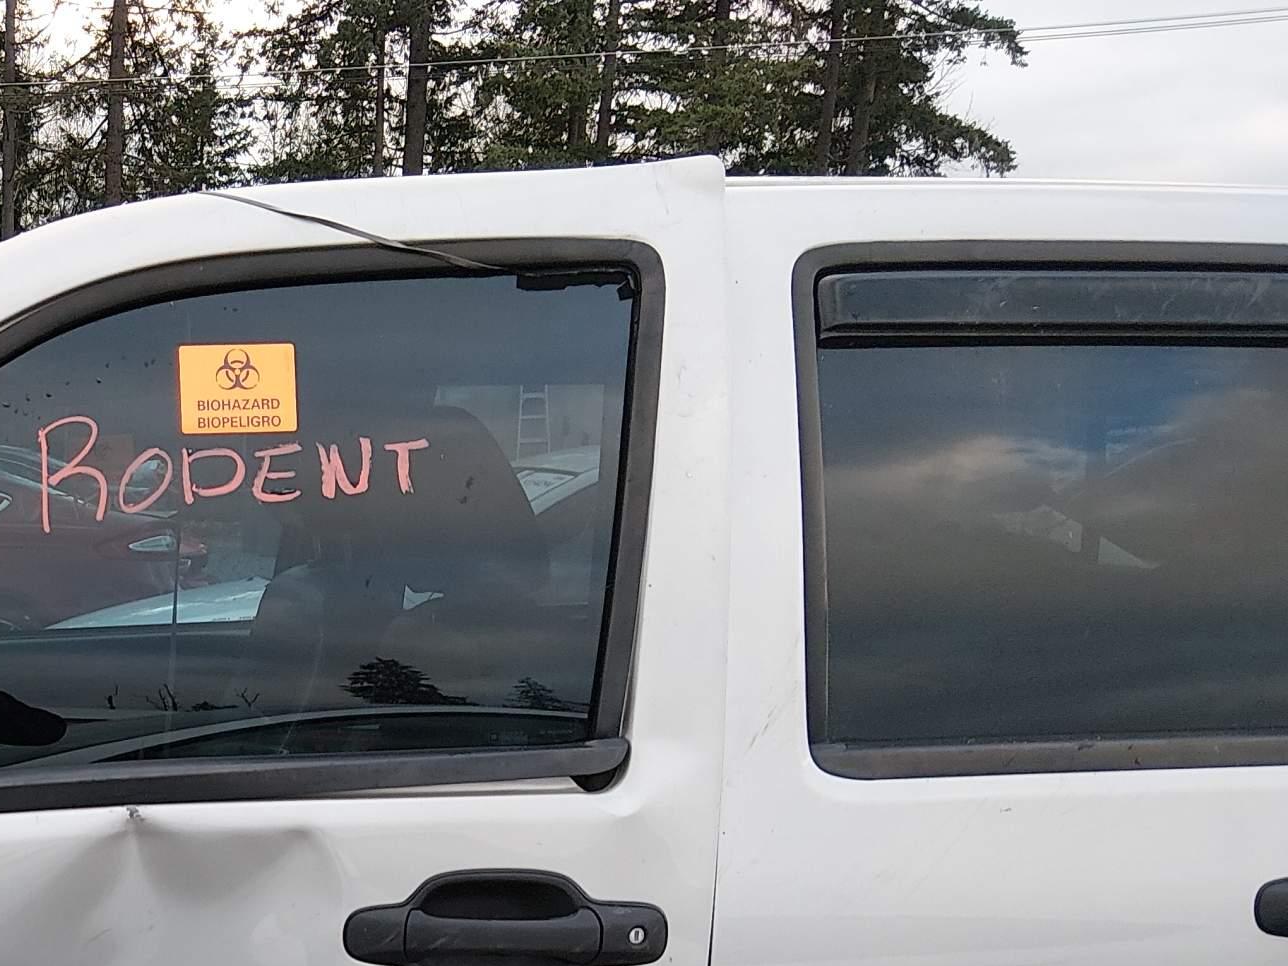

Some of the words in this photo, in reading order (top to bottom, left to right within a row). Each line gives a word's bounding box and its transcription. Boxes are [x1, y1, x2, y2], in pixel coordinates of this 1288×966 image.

[197, 398, 280, 411] BIOHAZARD
[197, 415, 281, 428] BIOPELIGRO
[39, 415, 429, 533] RODENT
